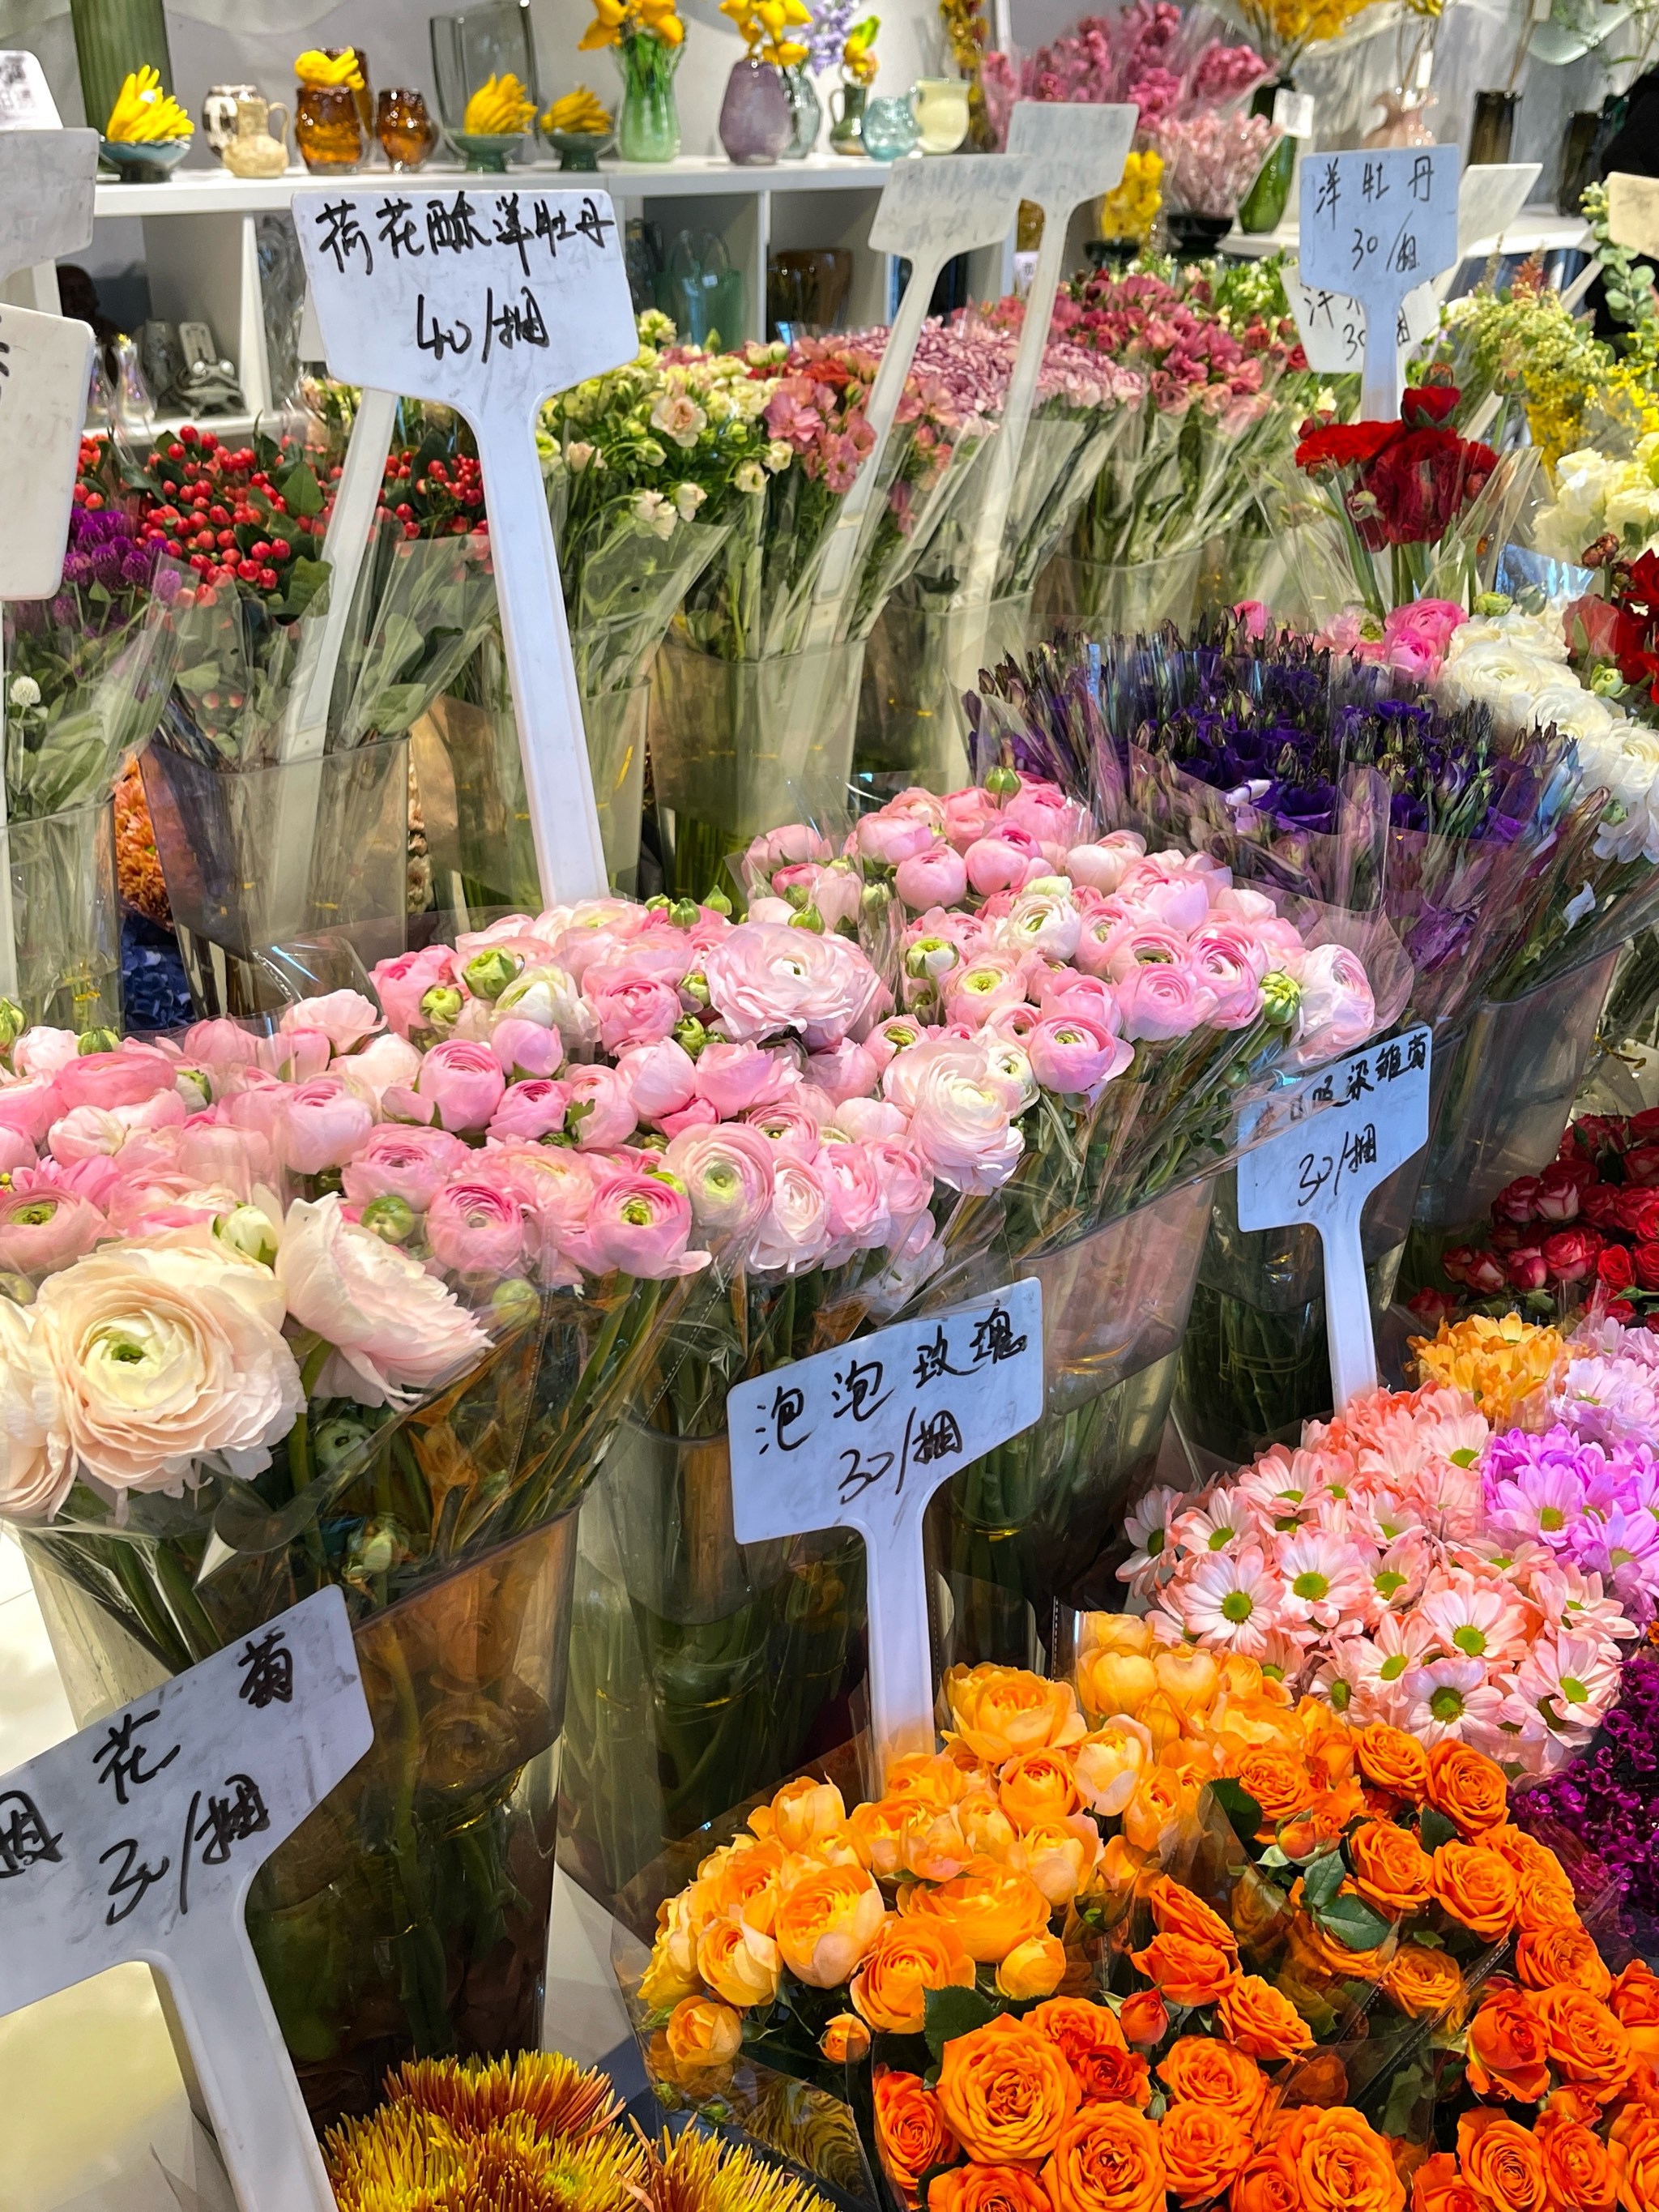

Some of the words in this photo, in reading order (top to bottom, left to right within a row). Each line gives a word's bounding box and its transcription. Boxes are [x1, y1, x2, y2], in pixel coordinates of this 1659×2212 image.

[1316, 156, 1435, 230] 洋牡丹
[417, 286, 549, 363] 40/捆
[1298, 1123, 1376, 1206] 30/捆
[755, 1300, 1028, 1454] 泡泡玫瑰
[838, 1407, 964, 1505] 30/捆
[99, 1774, 271, 1926] 30/捆
